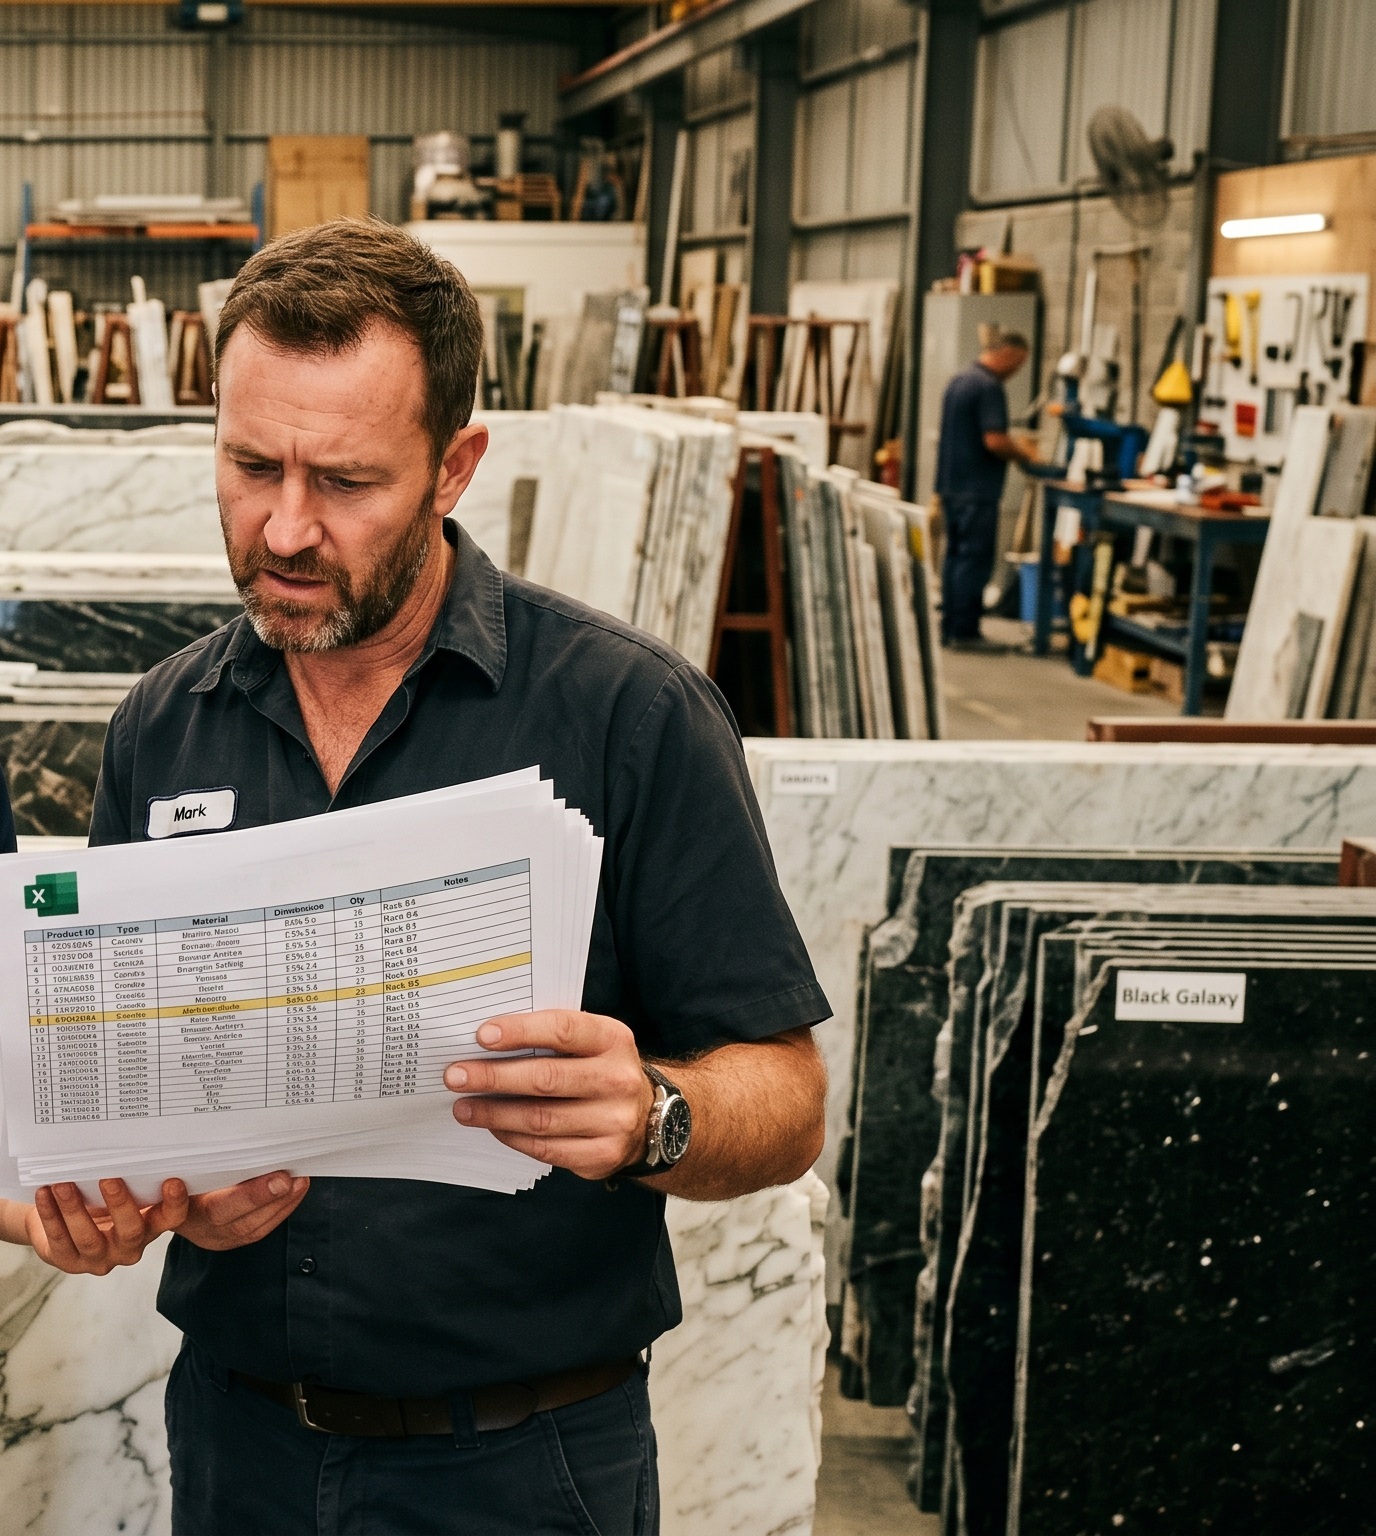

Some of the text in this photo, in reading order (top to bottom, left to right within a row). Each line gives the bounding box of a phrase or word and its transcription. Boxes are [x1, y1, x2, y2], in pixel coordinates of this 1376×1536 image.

[174, 803, 207, 822] Mark
[32, 889, 45, 904] X
[47, 930, 82, 939] Product
[192, 915, 228, 925] Material
[1122, 988, 1239, 1009] Black Galaxy
